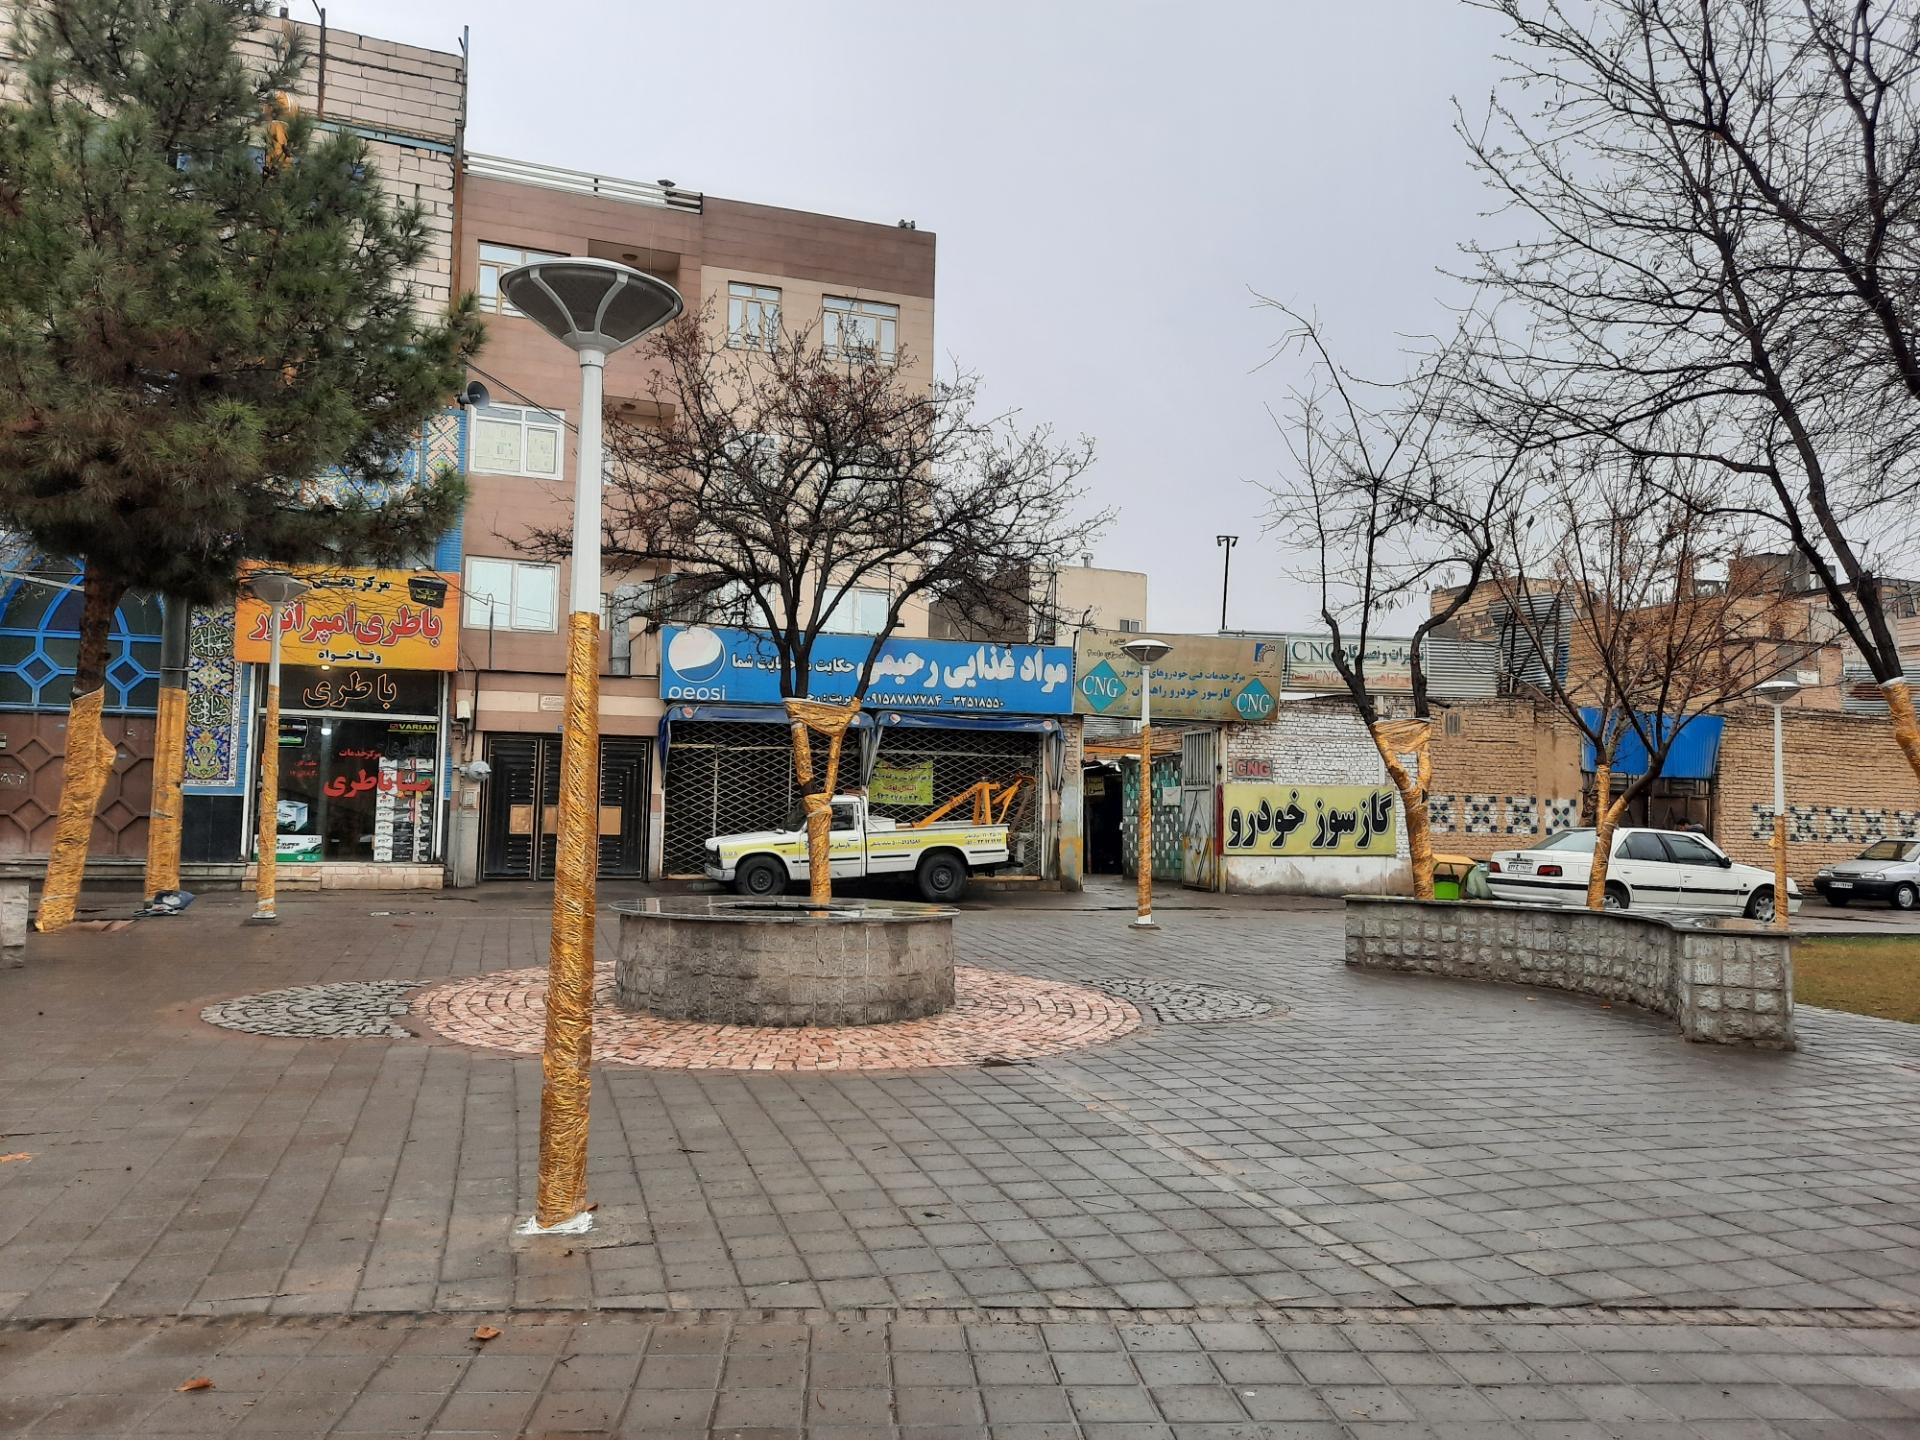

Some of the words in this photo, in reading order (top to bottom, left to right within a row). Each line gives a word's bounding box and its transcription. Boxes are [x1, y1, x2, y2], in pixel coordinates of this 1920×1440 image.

[360, 576, 391, 592] مرکز
[354, 604, 443, 647] باطری
[732, 653, 754, 668] شما
[815, 657, 855, 674] حکایت
[943, 645, 1016, 688] غذایی
[1019, 648, 1068, 693] مواد
[302, 670, 397, 710] باطری
[668, 685, 727, 700] pepsi
[1082, 675, 1119, 698] CNG
[1236, 695, 1270, 713] CNG
[399, 723, 437, 731] VARIAN
[1235, 761, 1271, 777] CNG
[1226, 788, 1307, 849] خودرو
